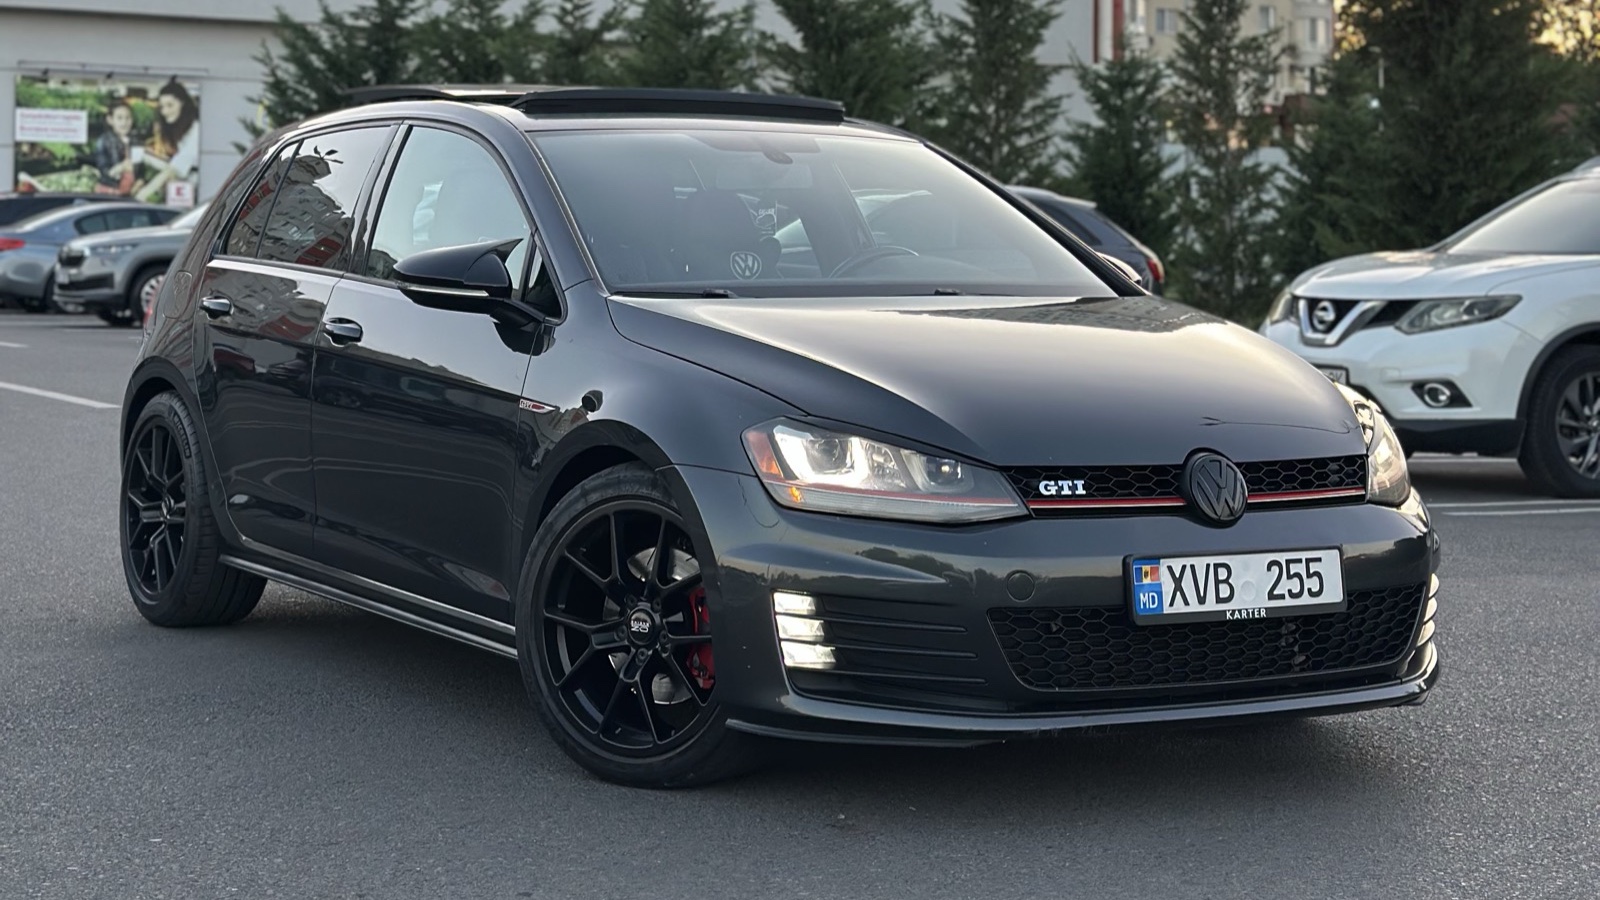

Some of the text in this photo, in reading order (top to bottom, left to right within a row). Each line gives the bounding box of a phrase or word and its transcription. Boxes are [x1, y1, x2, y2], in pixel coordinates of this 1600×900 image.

[173, 414, 191, 457] MICHELIN
[1038, 479, 1086, 496] GTI
[1166, 557, 1324, 607] XVB 255
[1139, 592, 1158, 609] MD
[1226, 608, 1267, 620] KARTER
